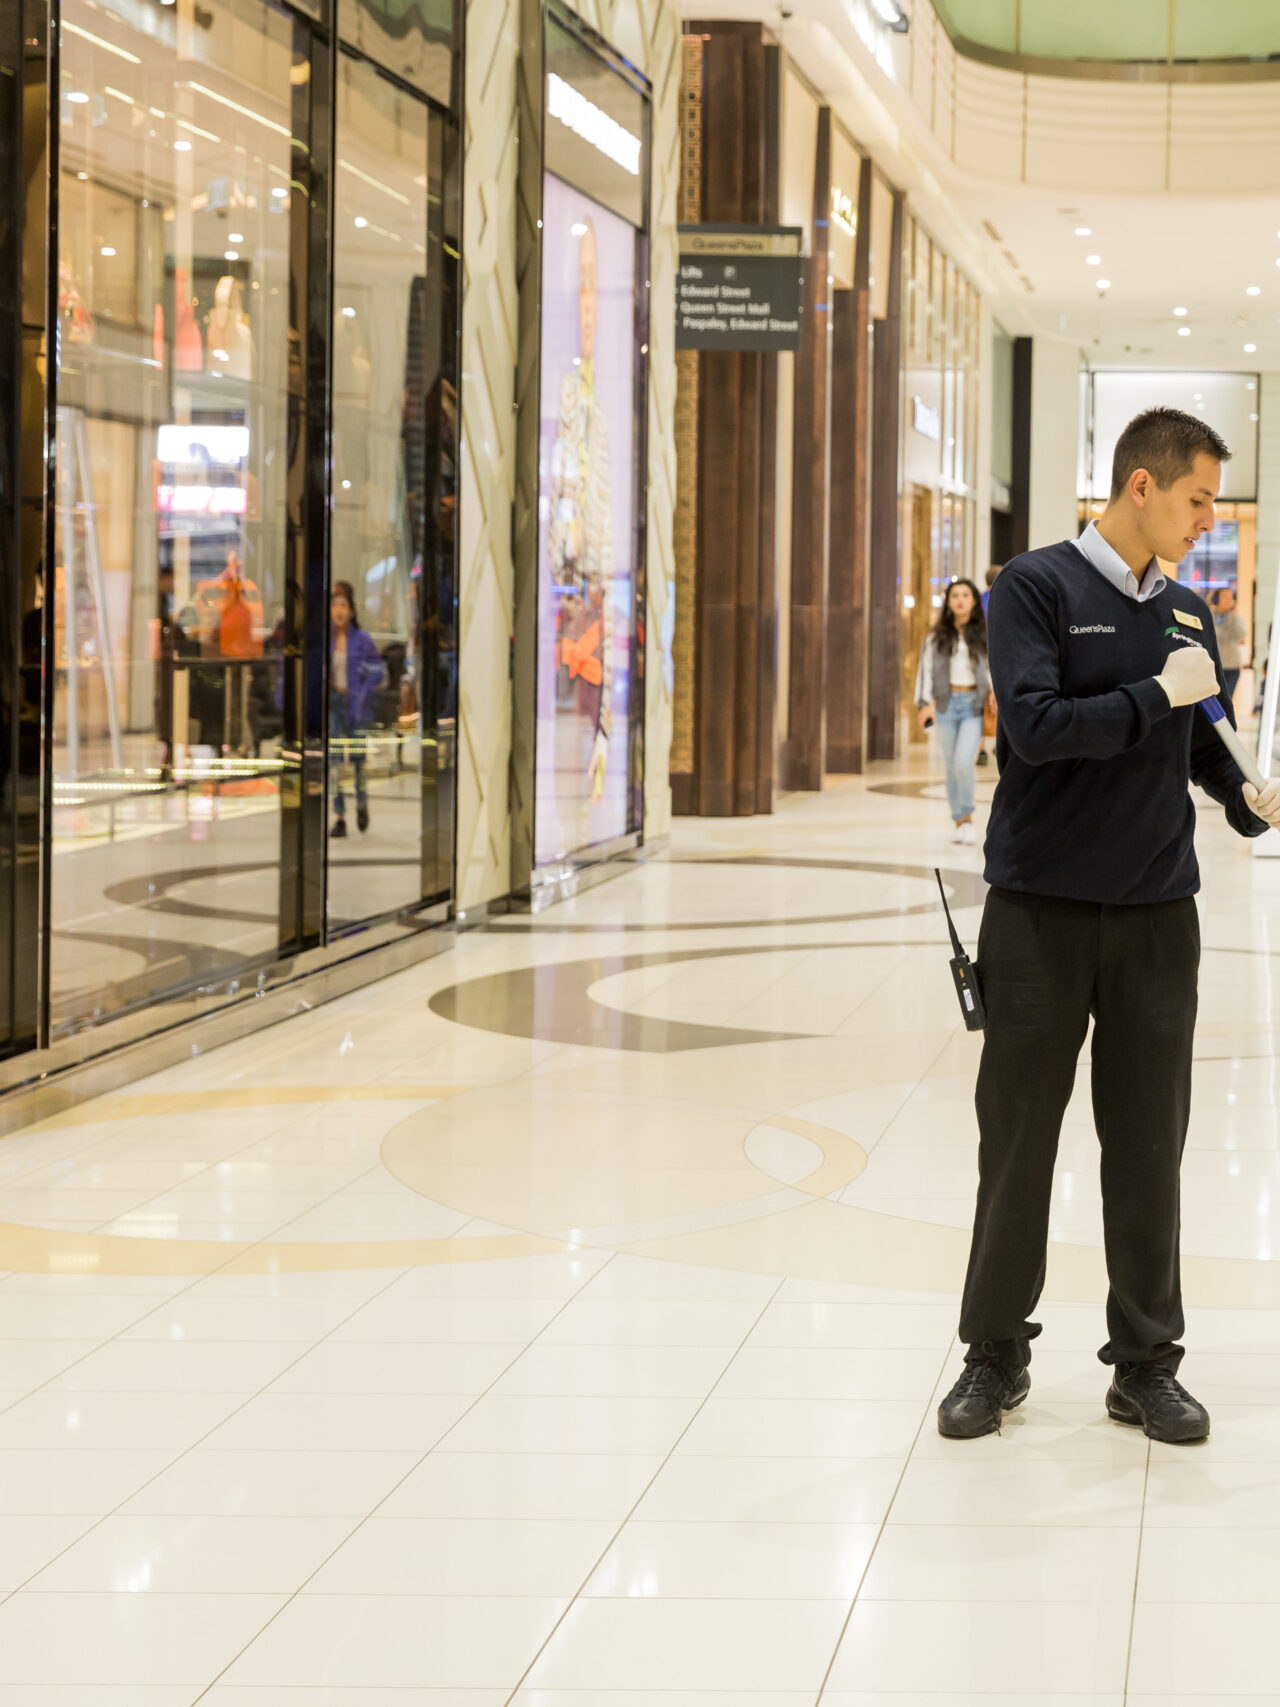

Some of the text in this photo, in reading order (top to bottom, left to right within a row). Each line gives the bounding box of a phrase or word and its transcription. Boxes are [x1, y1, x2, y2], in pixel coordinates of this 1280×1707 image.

[681, 284, 751, 299] Edward Street
[680, 301, 771, 316] Queen Street Mall
[729, 317, 768, 331] Edward
[768, 319, 799, 332] Street
[1069, 624, 1116, 634] QueensPlaza
